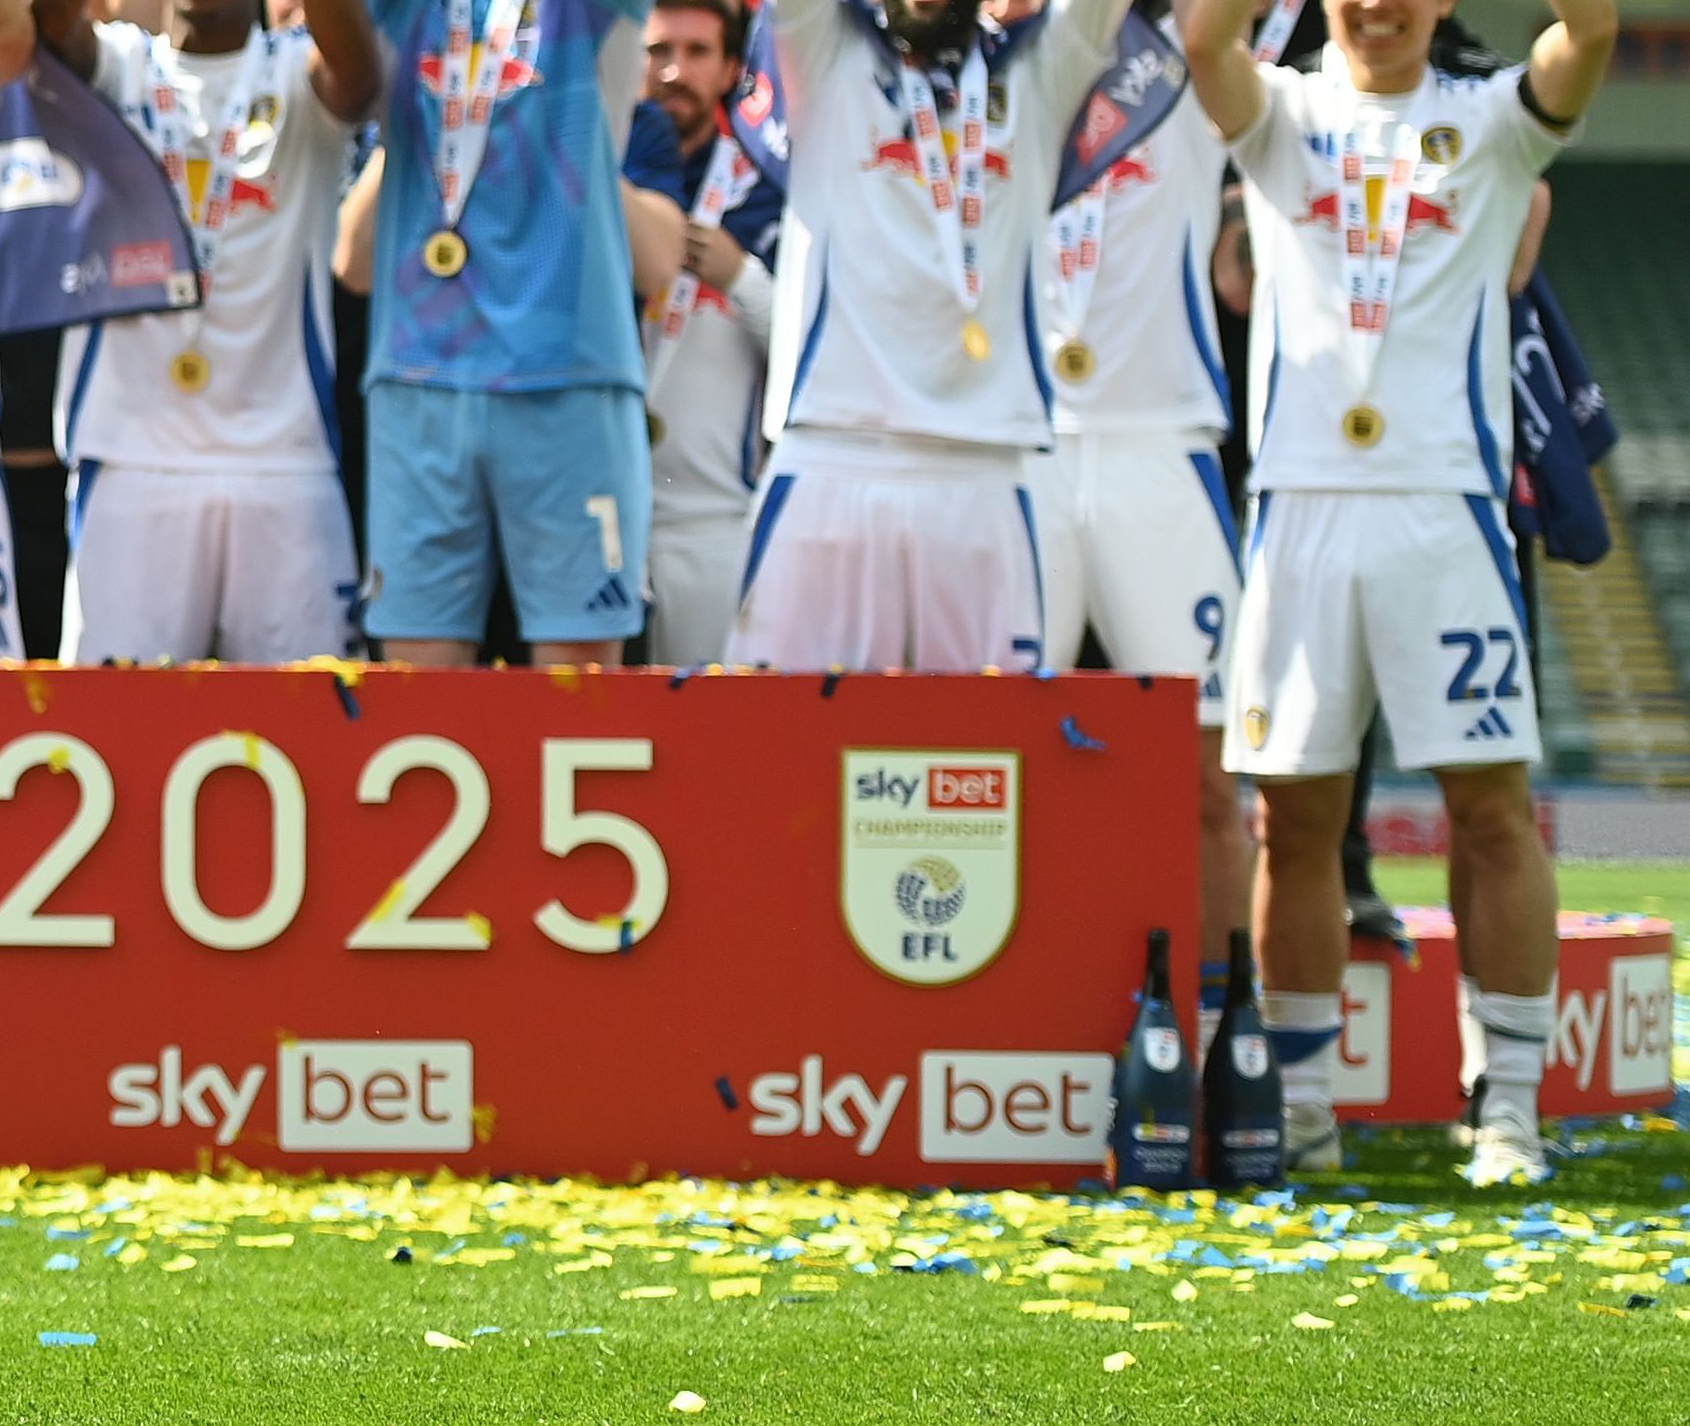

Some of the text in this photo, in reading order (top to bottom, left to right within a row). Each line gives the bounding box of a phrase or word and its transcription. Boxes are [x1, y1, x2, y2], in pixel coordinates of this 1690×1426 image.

[587, 496, 622, 571] 1
[1194, 595, 1222, 661] 9
[1441, 630, 1522, 701] 22
[857, 768, 1002, 808] sky bet
[901, 933, 958, 962] EFL
[1546, 968, 1607, 1091] ky
[108, 1046, 452, 1146] sky bet
[750, 1054, 1093, 1157] sky bet
